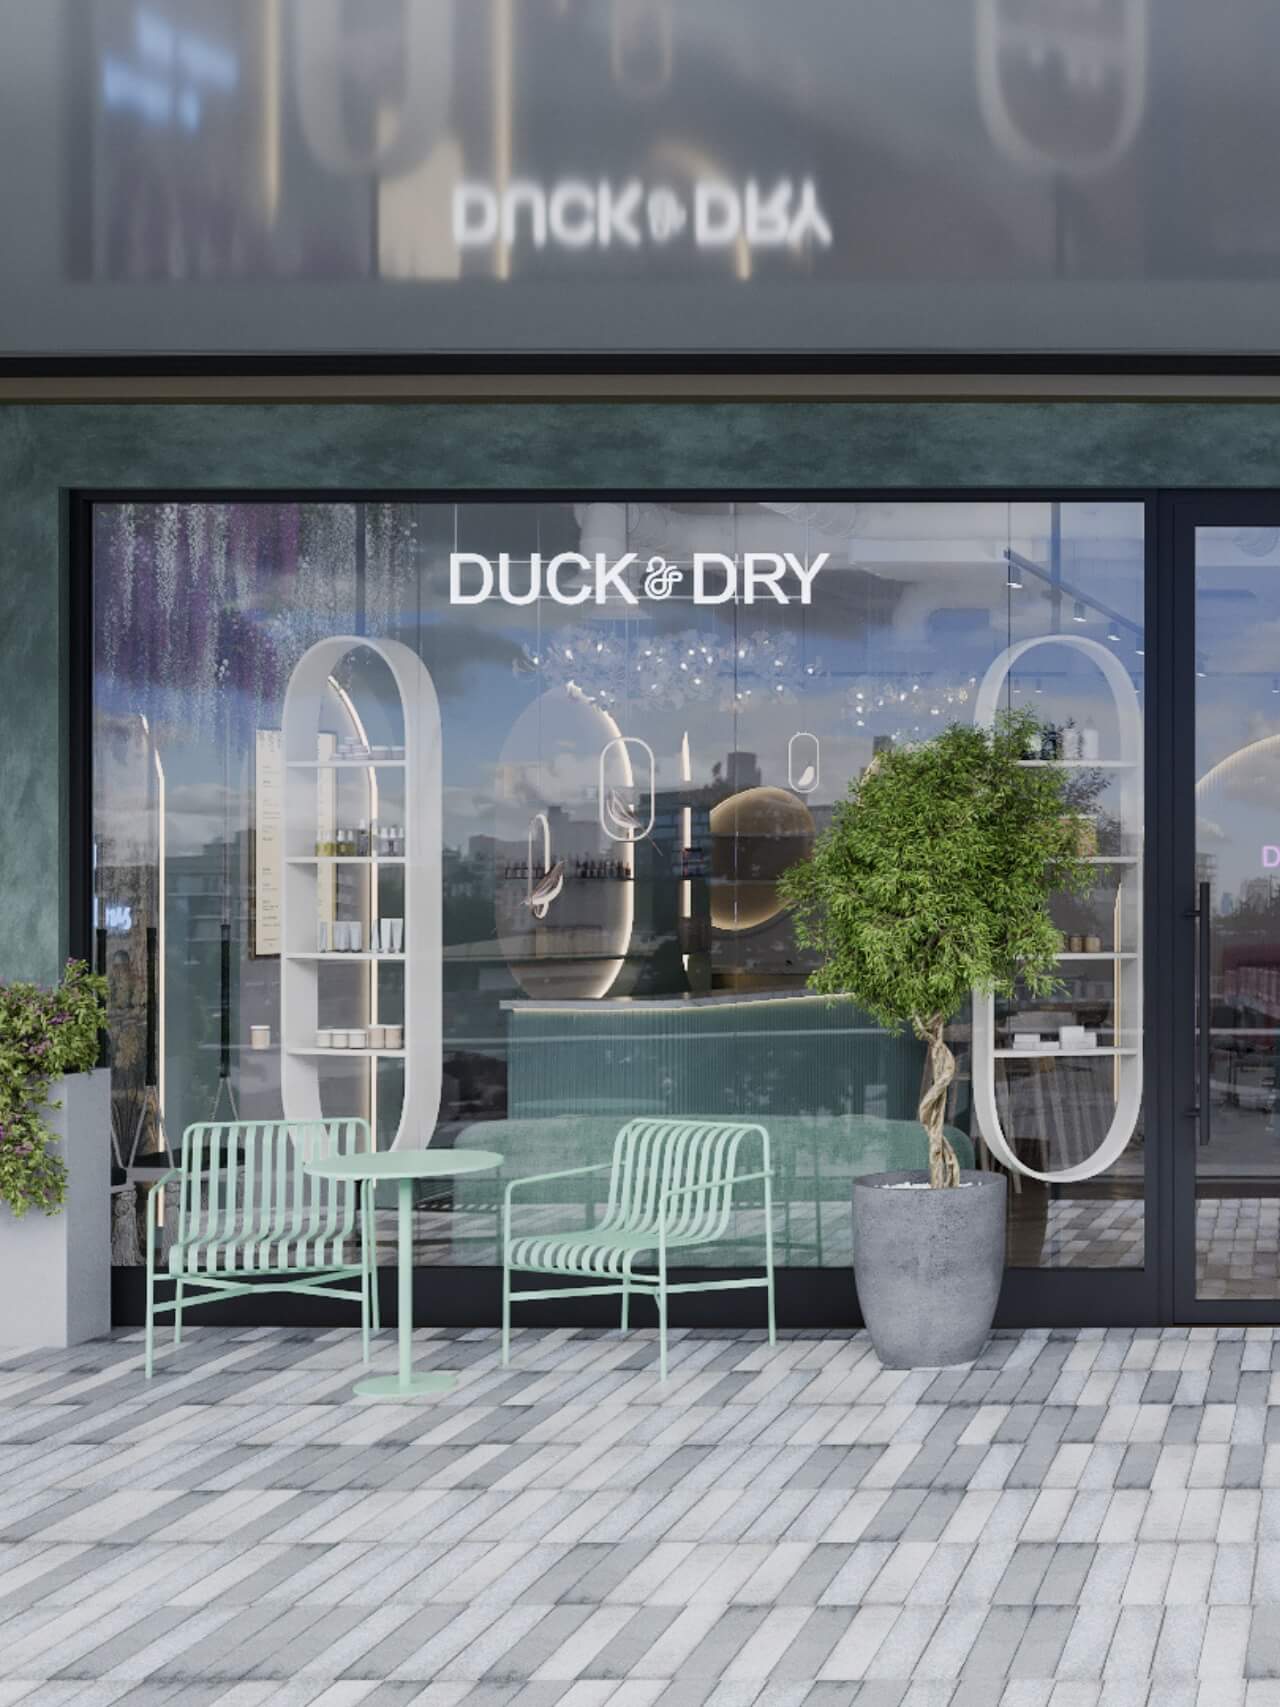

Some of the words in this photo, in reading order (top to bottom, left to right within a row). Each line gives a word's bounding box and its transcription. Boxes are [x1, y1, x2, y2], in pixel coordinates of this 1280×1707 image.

[450, 552, 639, 605] DUCK
[644, 556, 683, 601] &
[693, 553, 830, 605] DRY
